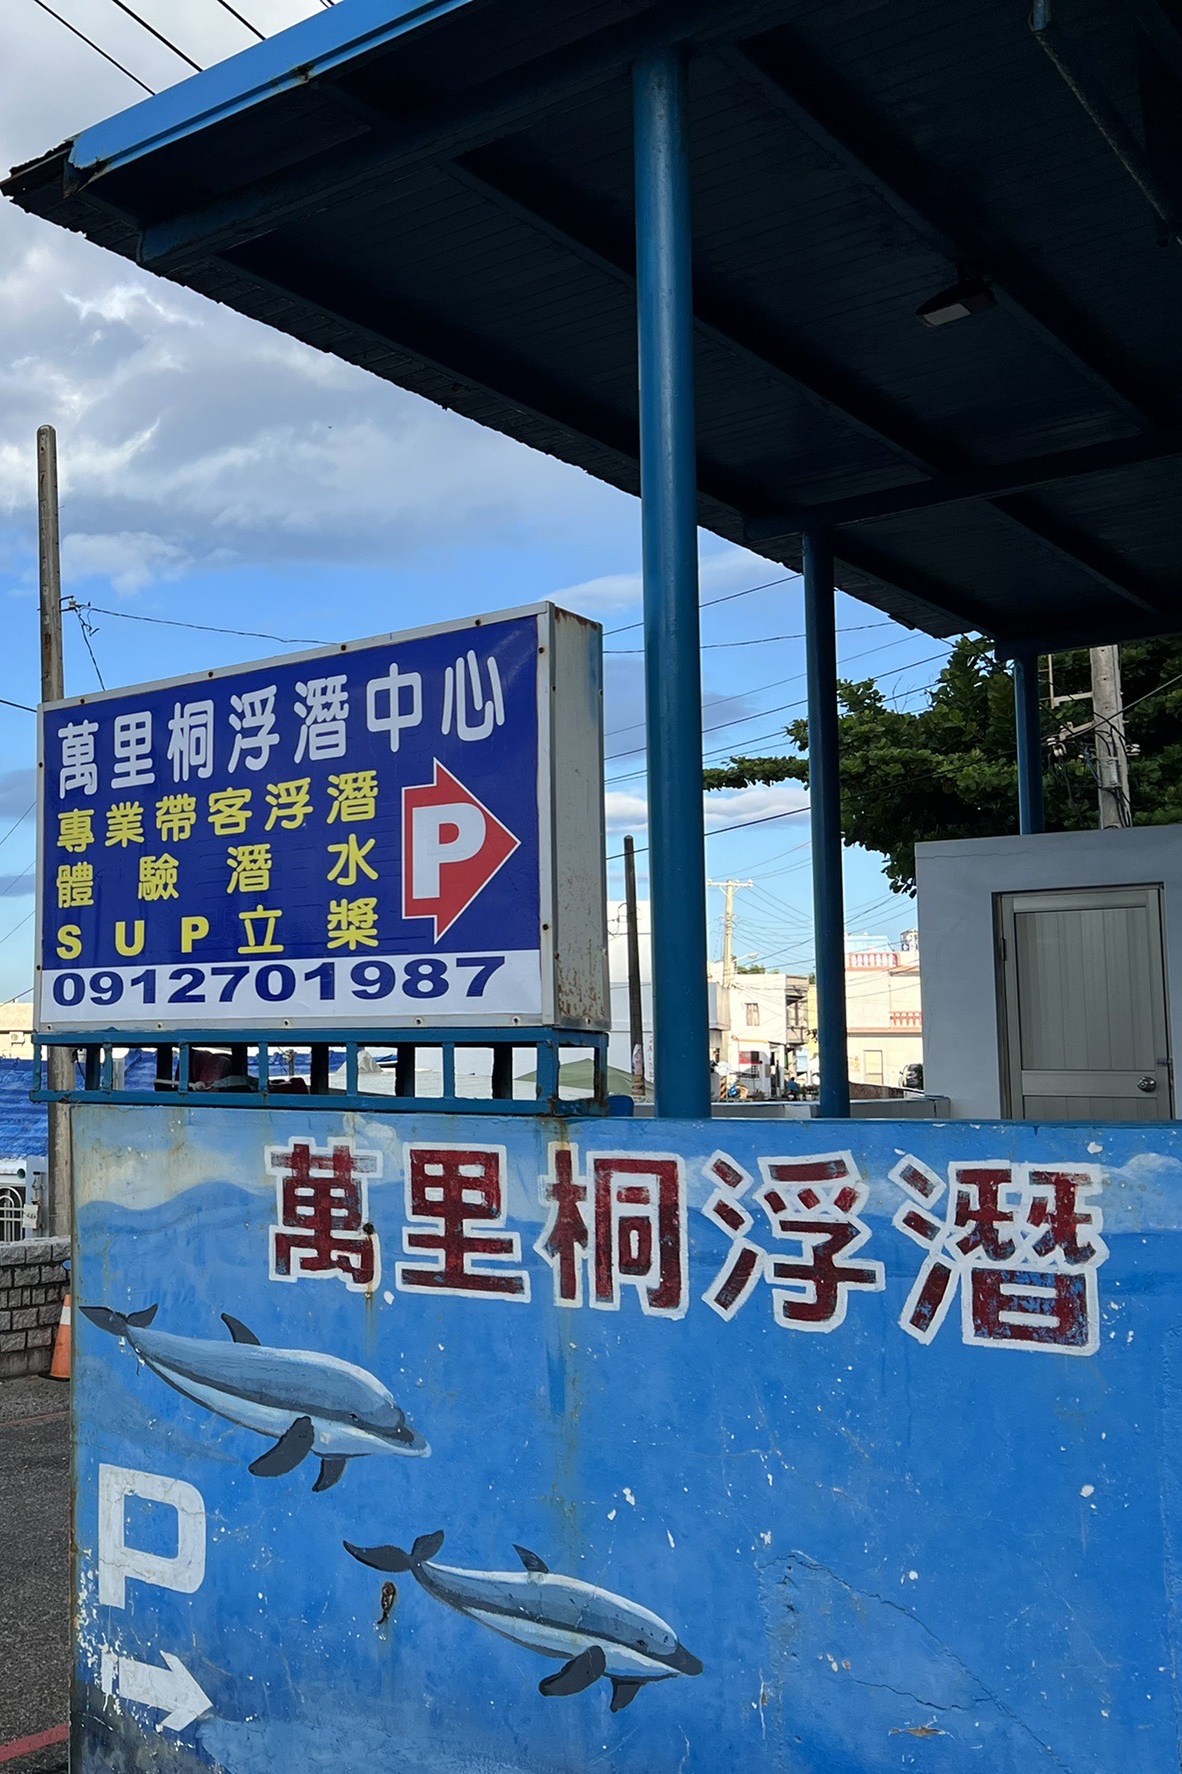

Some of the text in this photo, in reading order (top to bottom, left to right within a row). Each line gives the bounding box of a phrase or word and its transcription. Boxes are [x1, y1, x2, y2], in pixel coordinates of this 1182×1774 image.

[57, 648, 506, 801] 萬里桐浮潛中心
[57, 769, 379, 854] 專業帶客浮潛
[412, 802, 487, 901] P
[56, 833, 379, 909] 體驗潛水
[52, 955, 507, 1007] 0912701987
[264, 1135, 1110, 1357] 萬里桐浮潛
[98, 1463, 207, 1610] P
